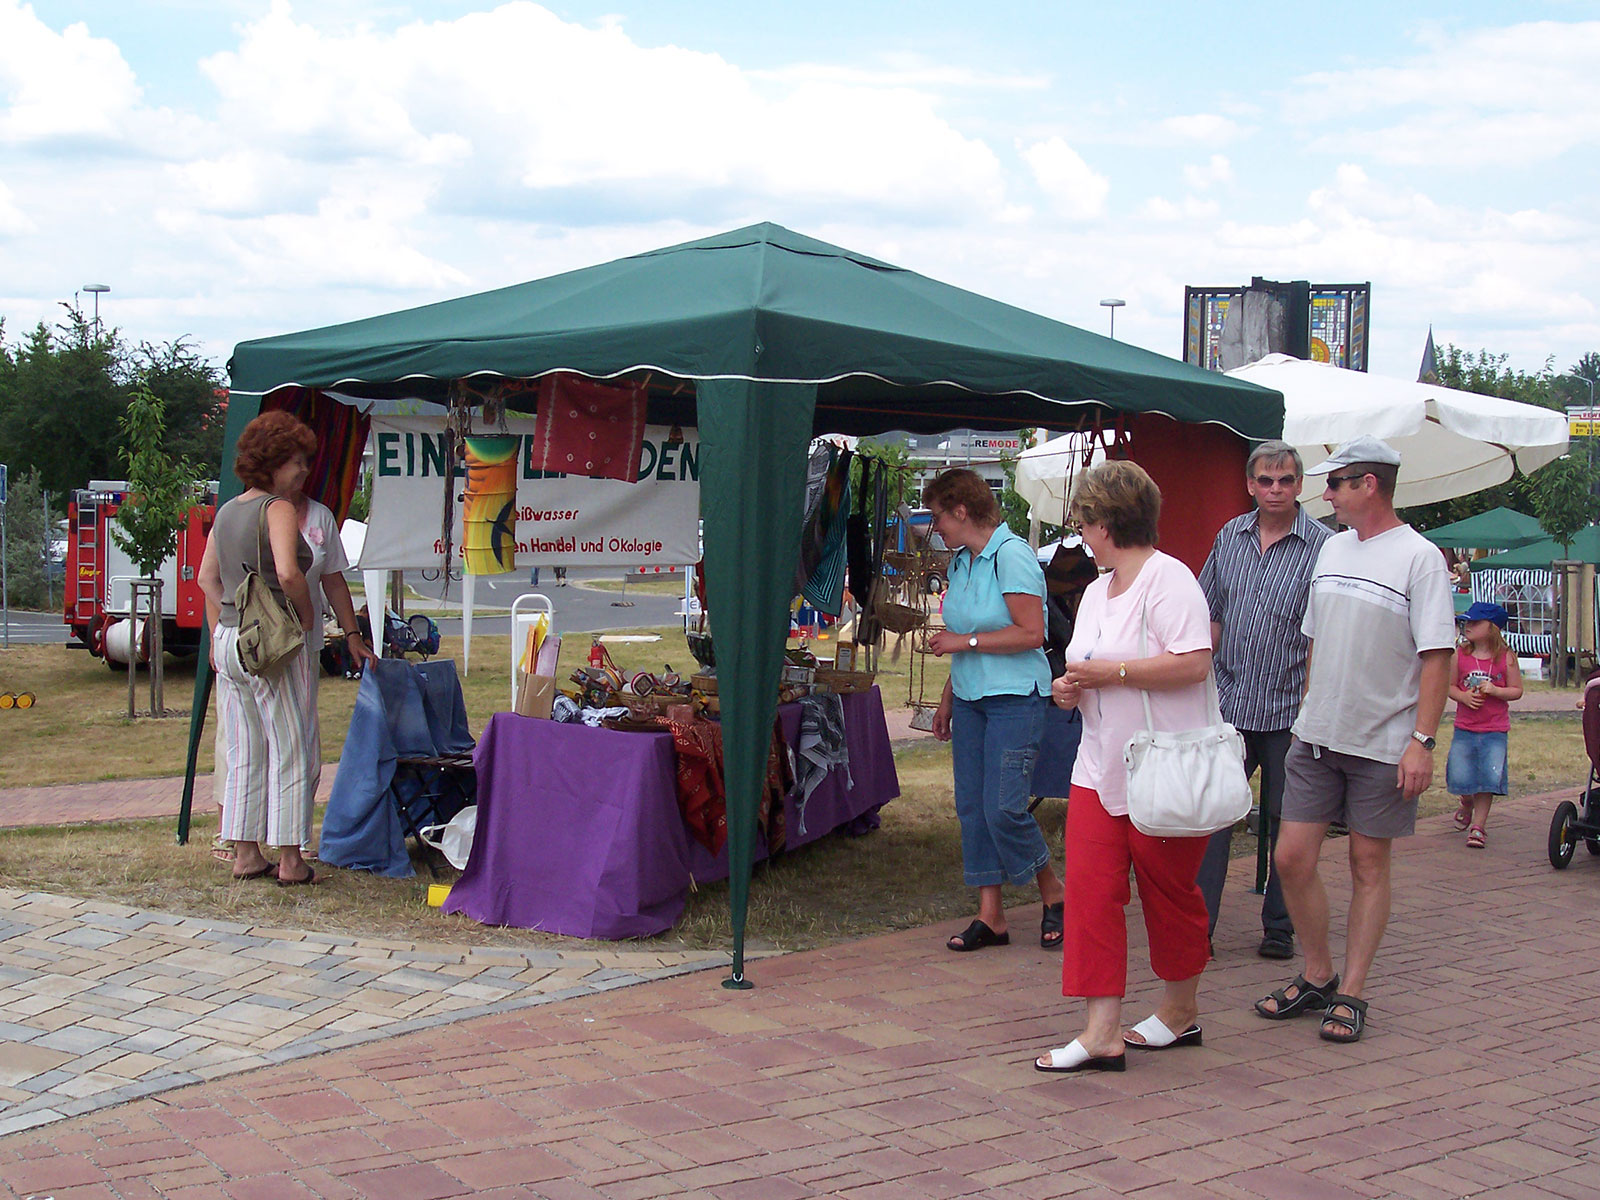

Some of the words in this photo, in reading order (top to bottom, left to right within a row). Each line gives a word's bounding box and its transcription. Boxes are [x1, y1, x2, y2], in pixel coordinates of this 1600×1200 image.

[974, 439, 1019, 448] REMODE
[514, 506, 579, 521] eißwasser
[530, 536, 576, 554] Handel
[580, 536, 604, 553] und
